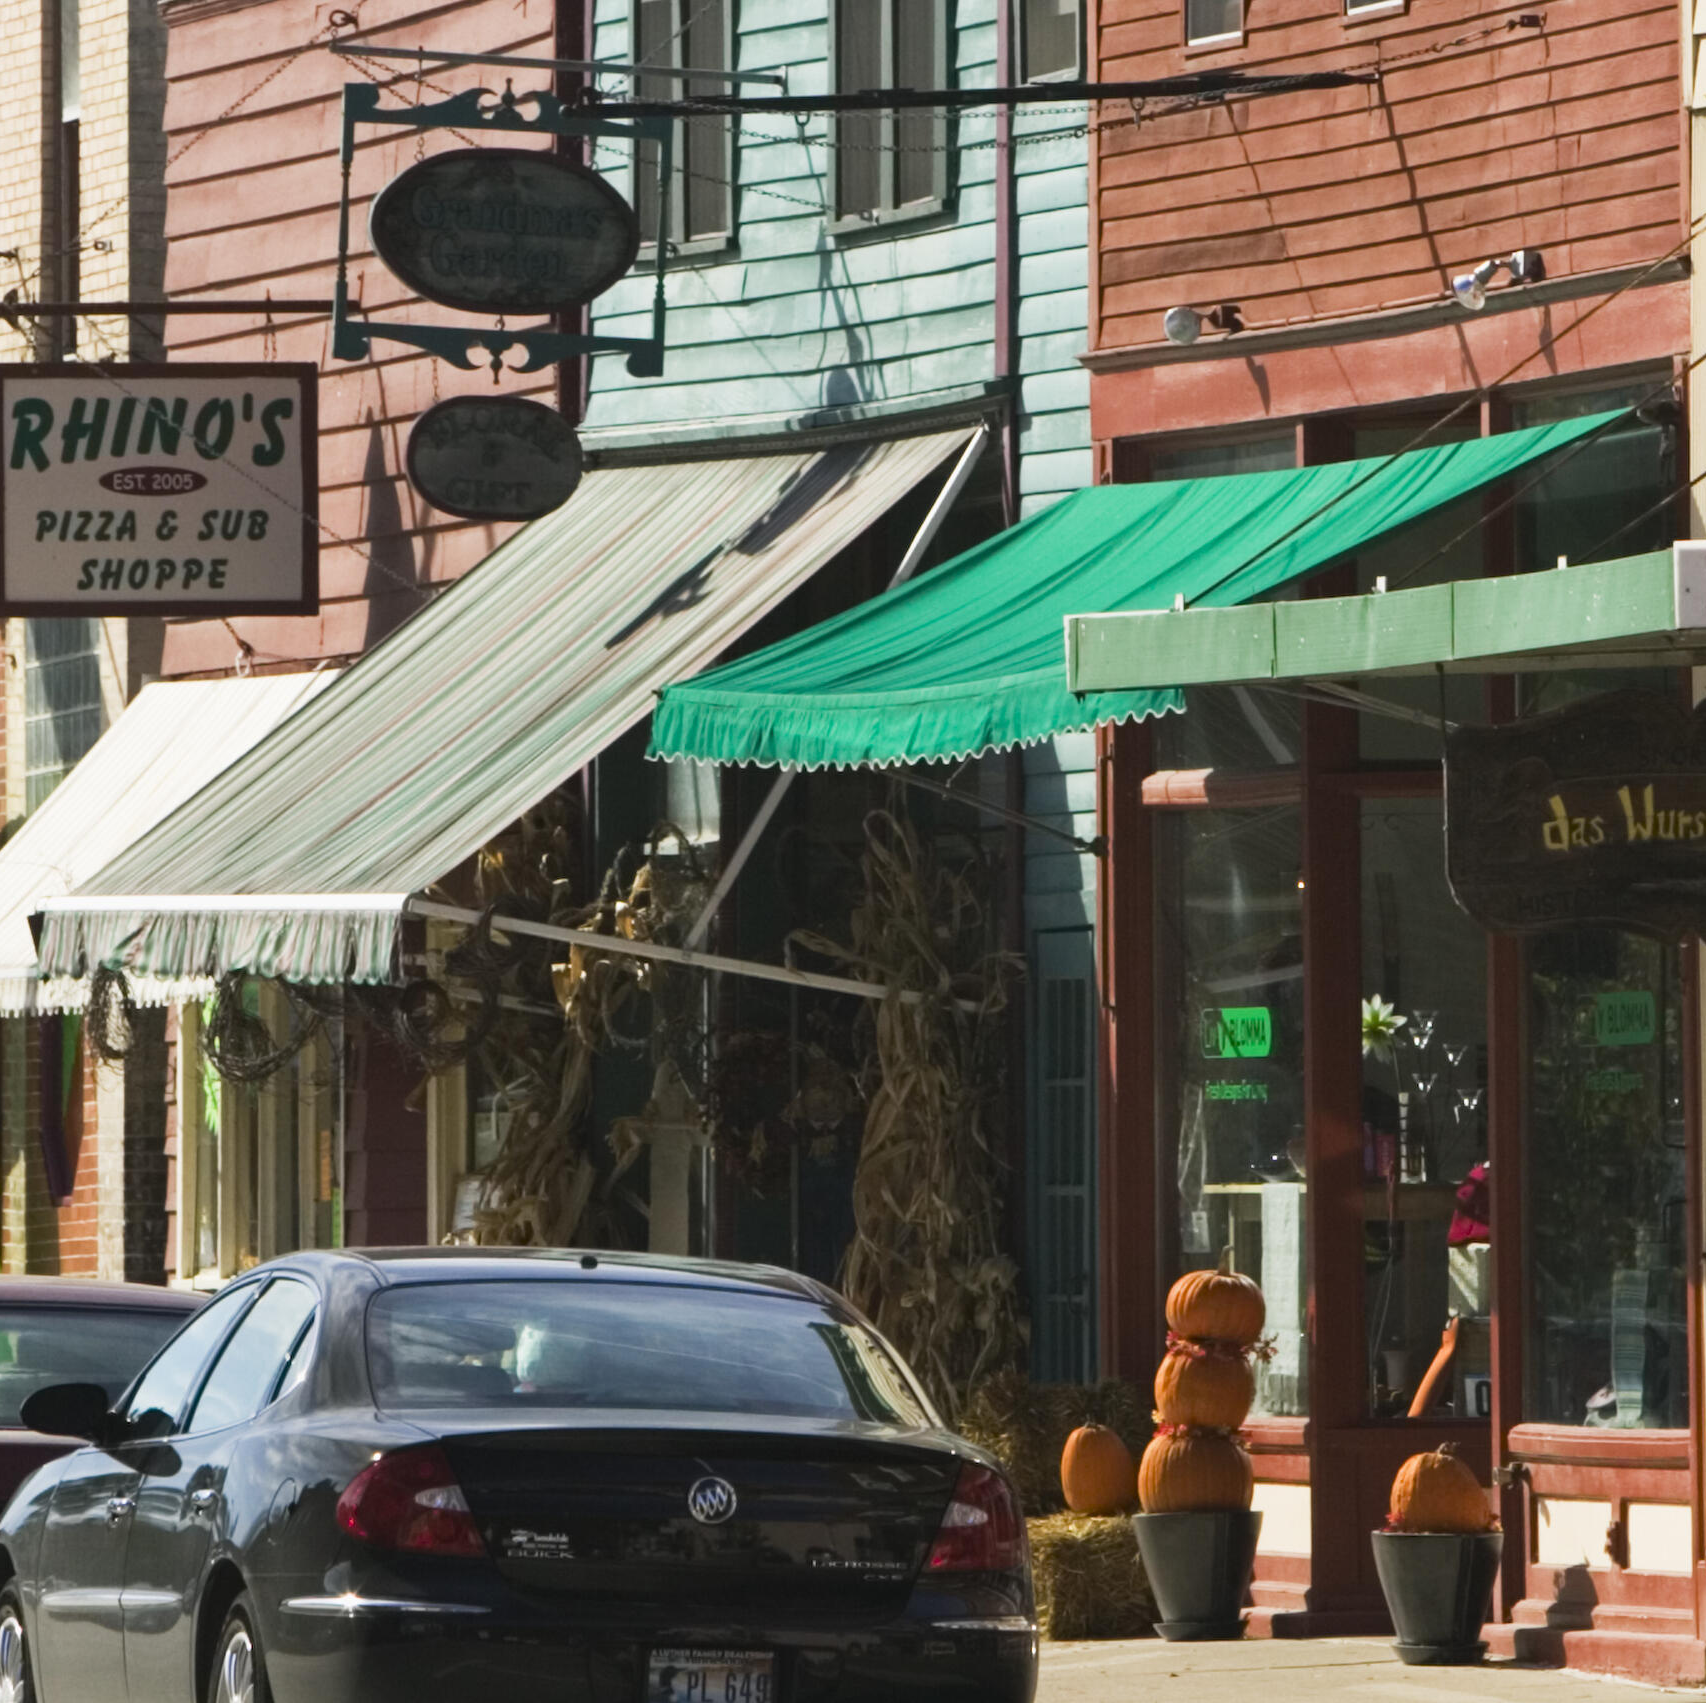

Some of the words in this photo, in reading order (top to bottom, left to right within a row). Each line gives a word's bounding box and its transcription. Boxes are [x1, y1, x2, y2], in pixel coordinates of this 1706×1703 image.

[430, 232, 570, 279] Garden
[10, 392, 293, 472] RHINO'S
[113, 473, 146, 490] EST.
[151, 472, 194, 491] 2005
[35, 510, 137, 542] PIZZA
[156, 511, 178, 540] &
[198, 509, 269, 541] SUB
[77, 559, 228, 591] SHOPPE
[1542, 793, 1606, 854] das
[507, 1549, 575, 1559] BUICK
[686, 1671, 714, 1703] PL
[725, 1672, 770, 1703] 649
